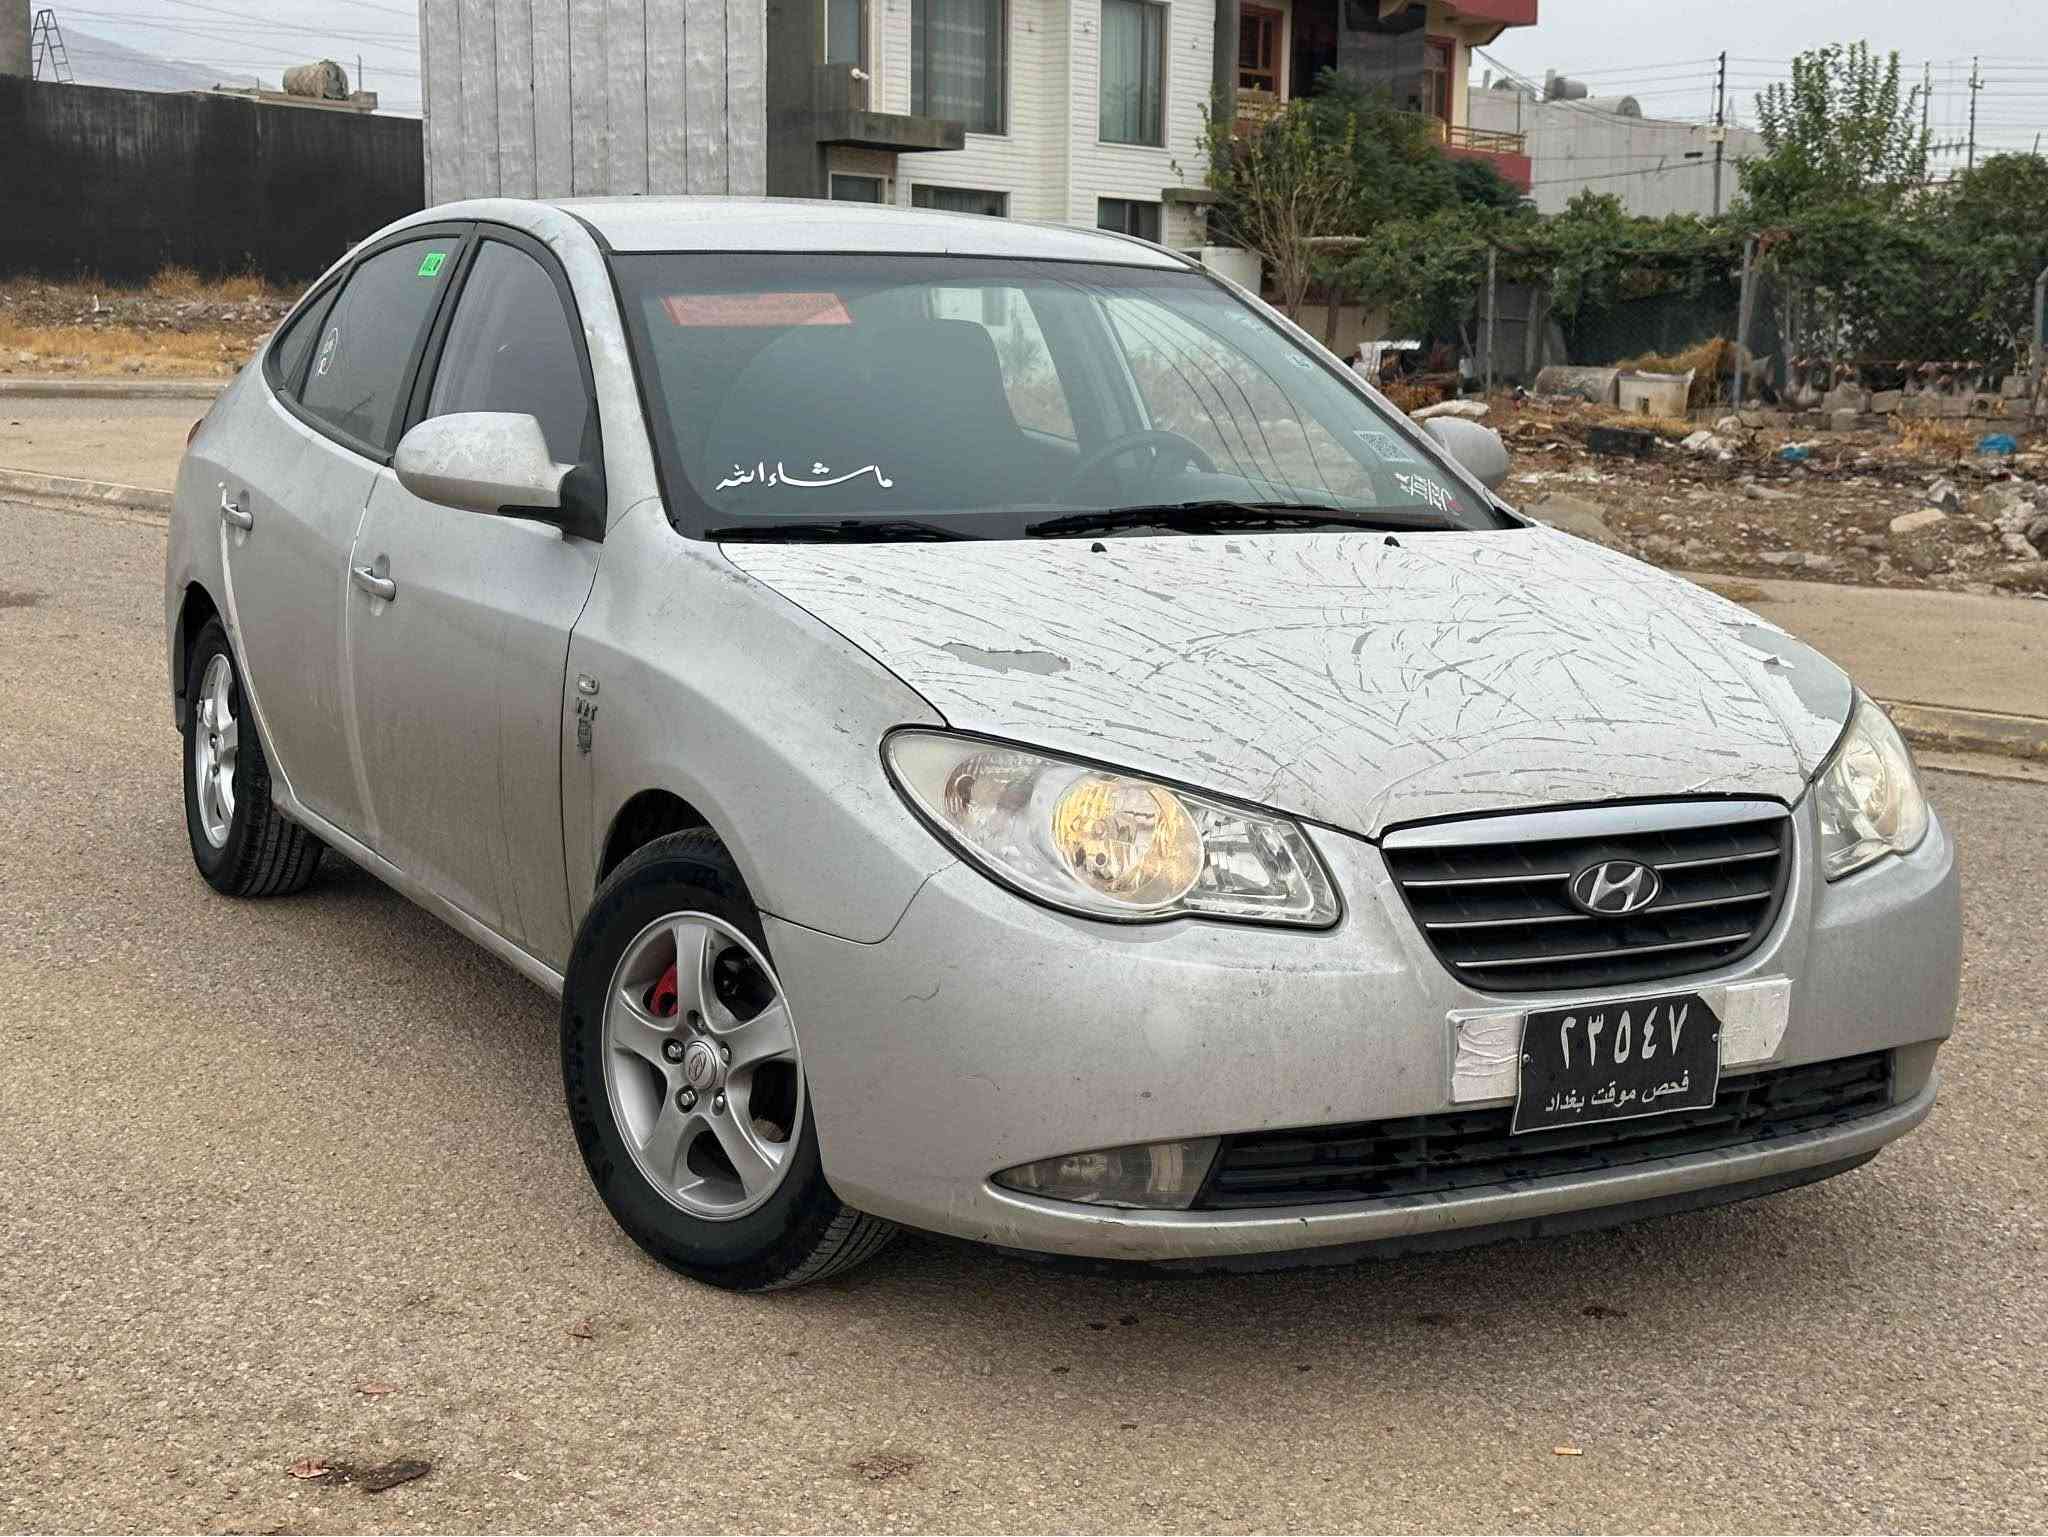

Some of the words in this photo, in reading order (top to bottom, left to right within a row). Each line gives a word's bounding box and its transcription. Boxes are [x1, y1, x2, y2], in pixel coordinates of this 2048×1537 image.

[1560, 1003, 1689, 1070] ٢٣٥٤٧
[1545, 1088, 1586, 1113] بغداد
[1591, 1080, 1637, 1108] موقت
[1641, 1069, 1690, 1103] فحص
